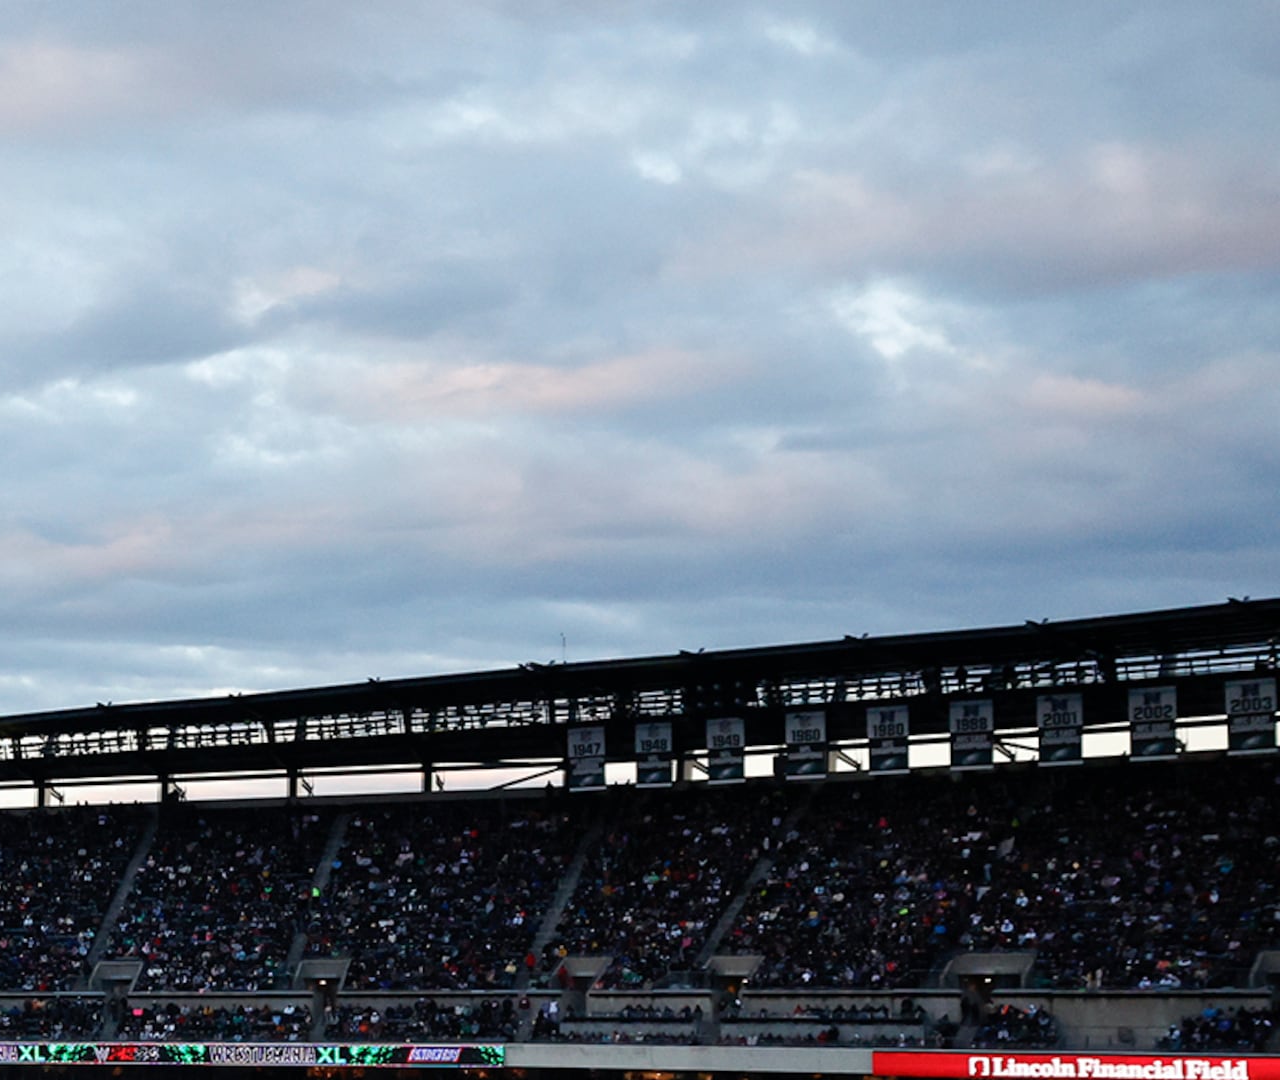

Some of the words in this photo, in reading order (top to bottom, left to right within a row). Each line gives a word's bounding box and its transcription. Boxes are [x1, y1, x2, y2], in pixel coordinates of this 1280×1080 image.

[18, 1046, 45, 1061] XL
[317, 1047, 347, 1064] XL
[992, 1057, 1076, 1078] Lincoln
[1077, 1057, 1183, 1079] Financial
[1185, 1060, 1249, 1080] Field
